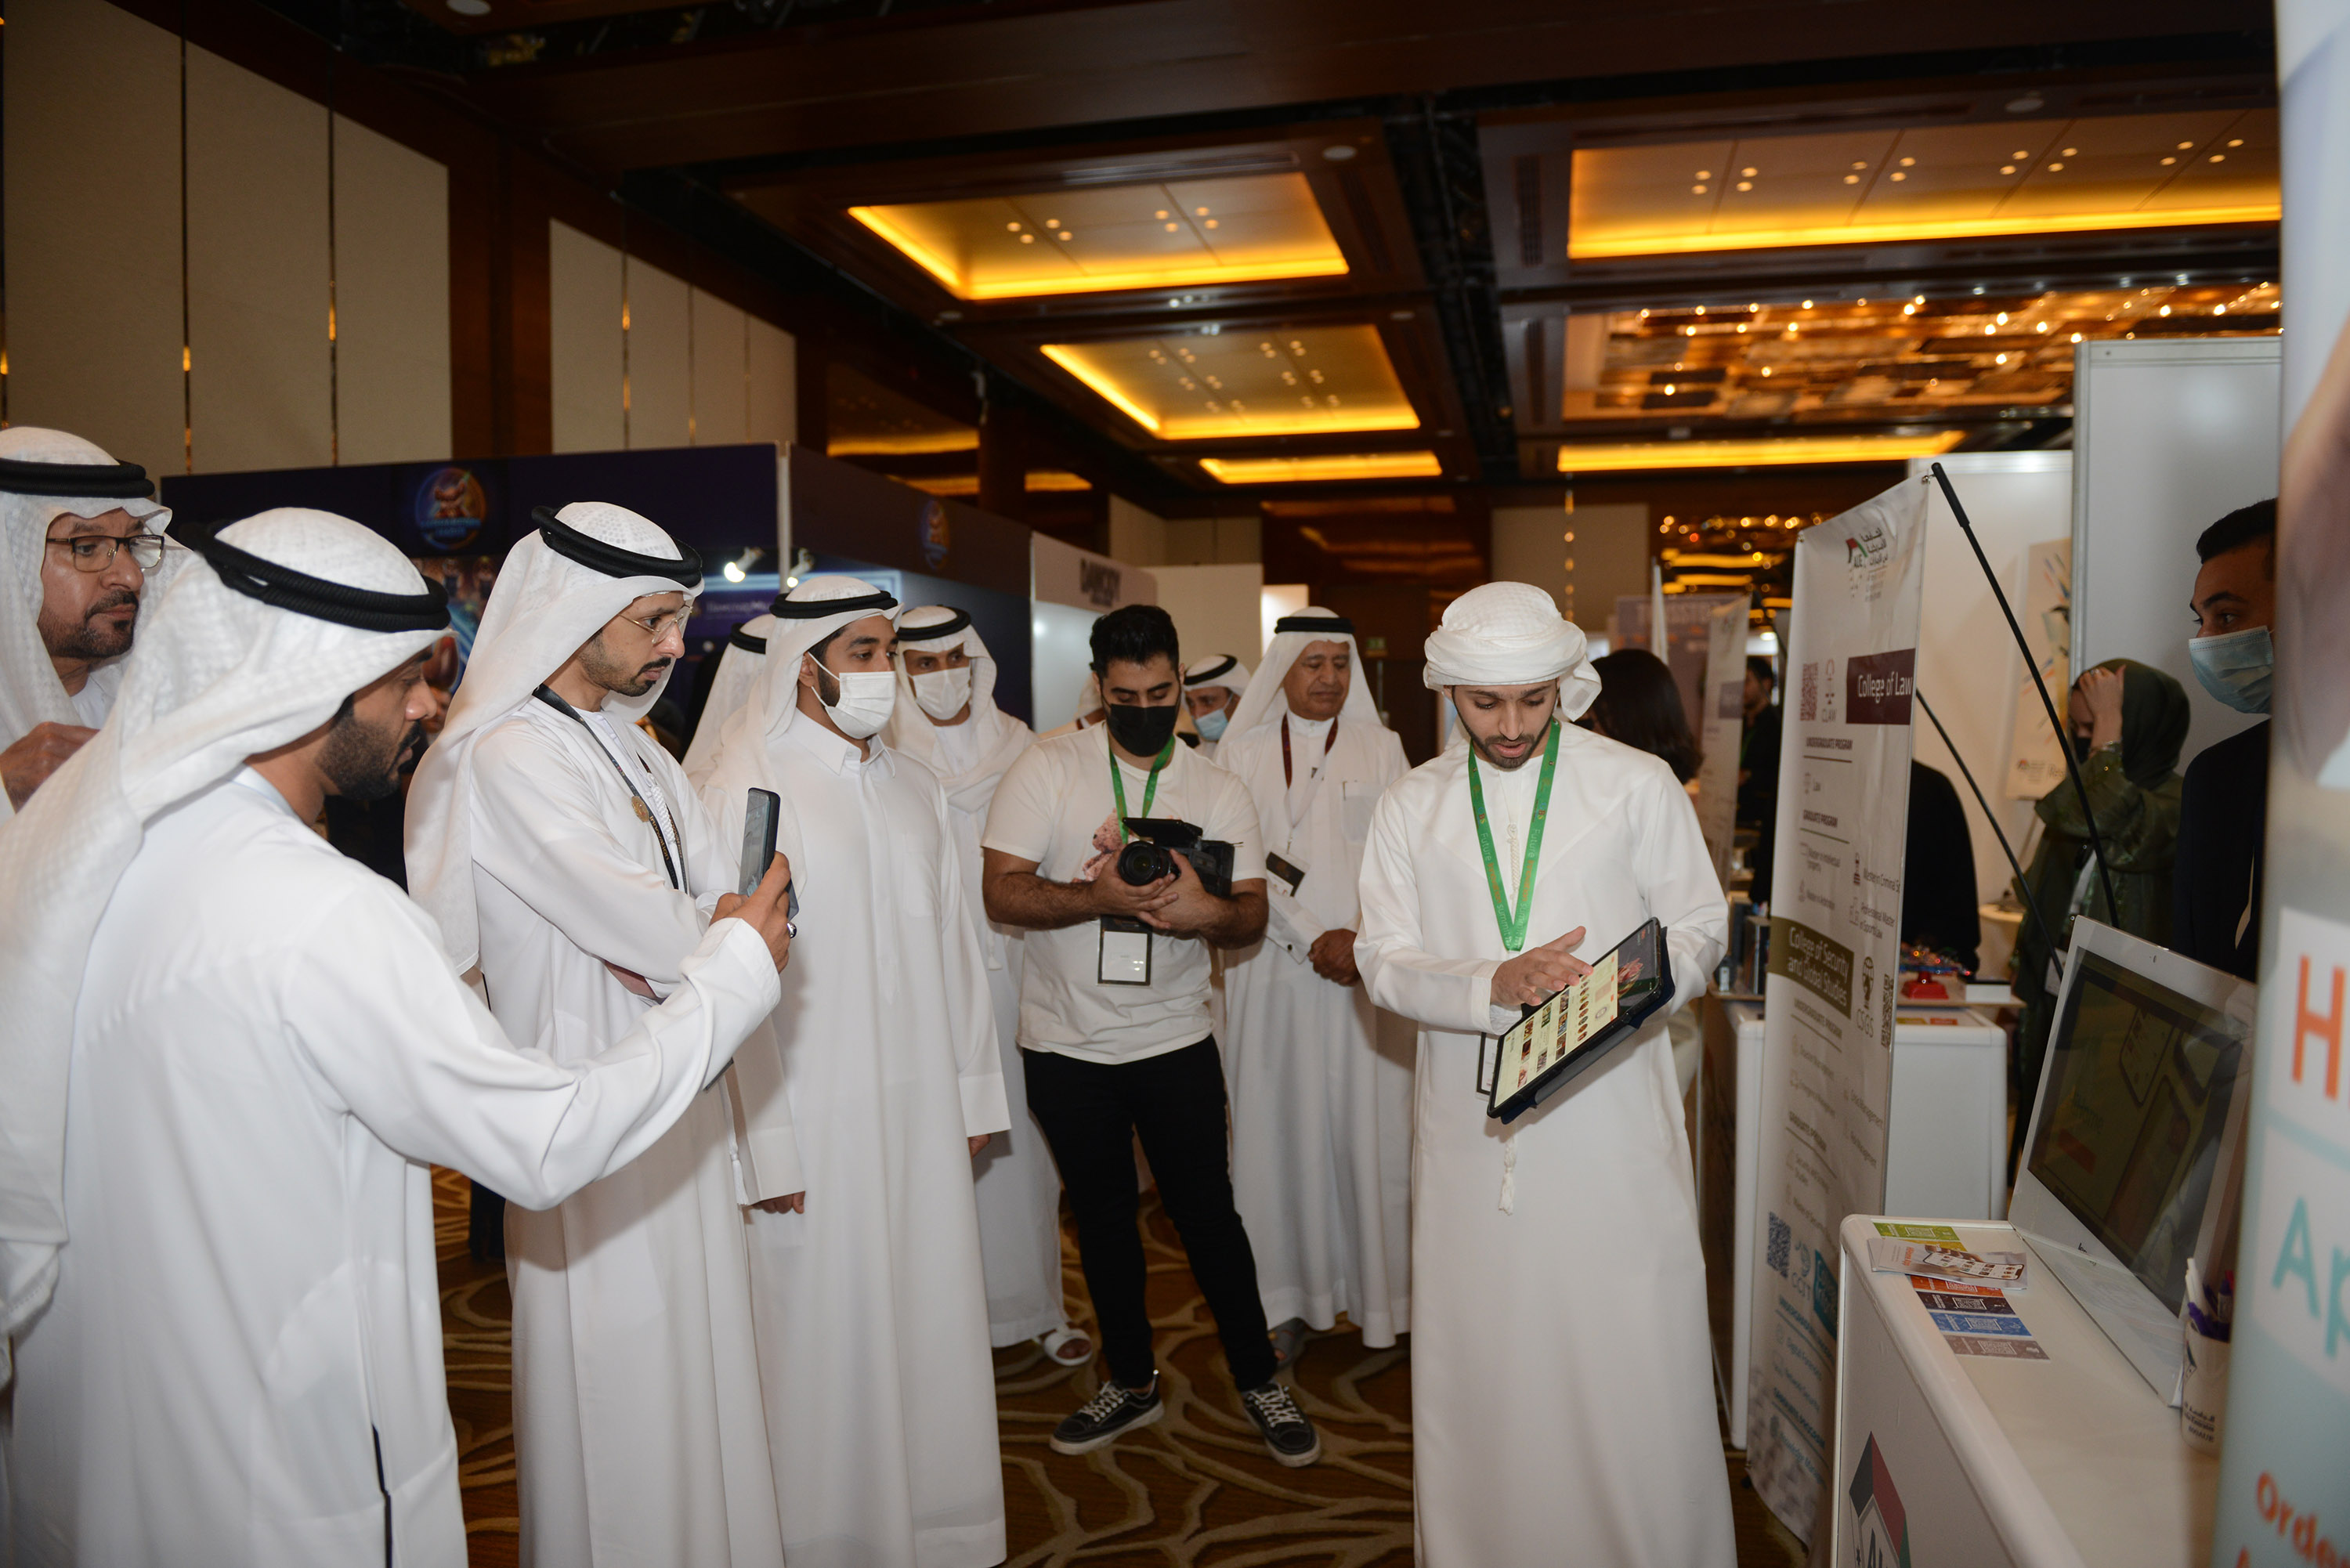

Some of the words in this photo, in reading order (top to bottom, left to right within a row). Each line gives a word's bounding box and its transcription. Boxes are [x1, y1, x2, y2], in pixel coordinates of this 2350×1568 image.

[1858, 674, 1885, 704] College
[1886, 676, 1894, 697] of
[1895, 671, 1913, 696] Law
[1821, 708, 1837, 723] CLAW
[649, 815, 670, 861] Innovation
[1480, 833, 1492, 862] Future
[1528, 829, 1541, 858] Future
[1789, 927, 1815, 963] College
[1815, 940, 1823, 961] of
[1824, 944, 1849, 985] Security
[1788, 956, 1803, 977] and
[1803, 962, 1823, 988] Global
[1824, 971, 1847, 1006] Studies
[1856, 1008, 1874, 1038] CSGS
[2257, 1469, 2350, 1568] Orde
